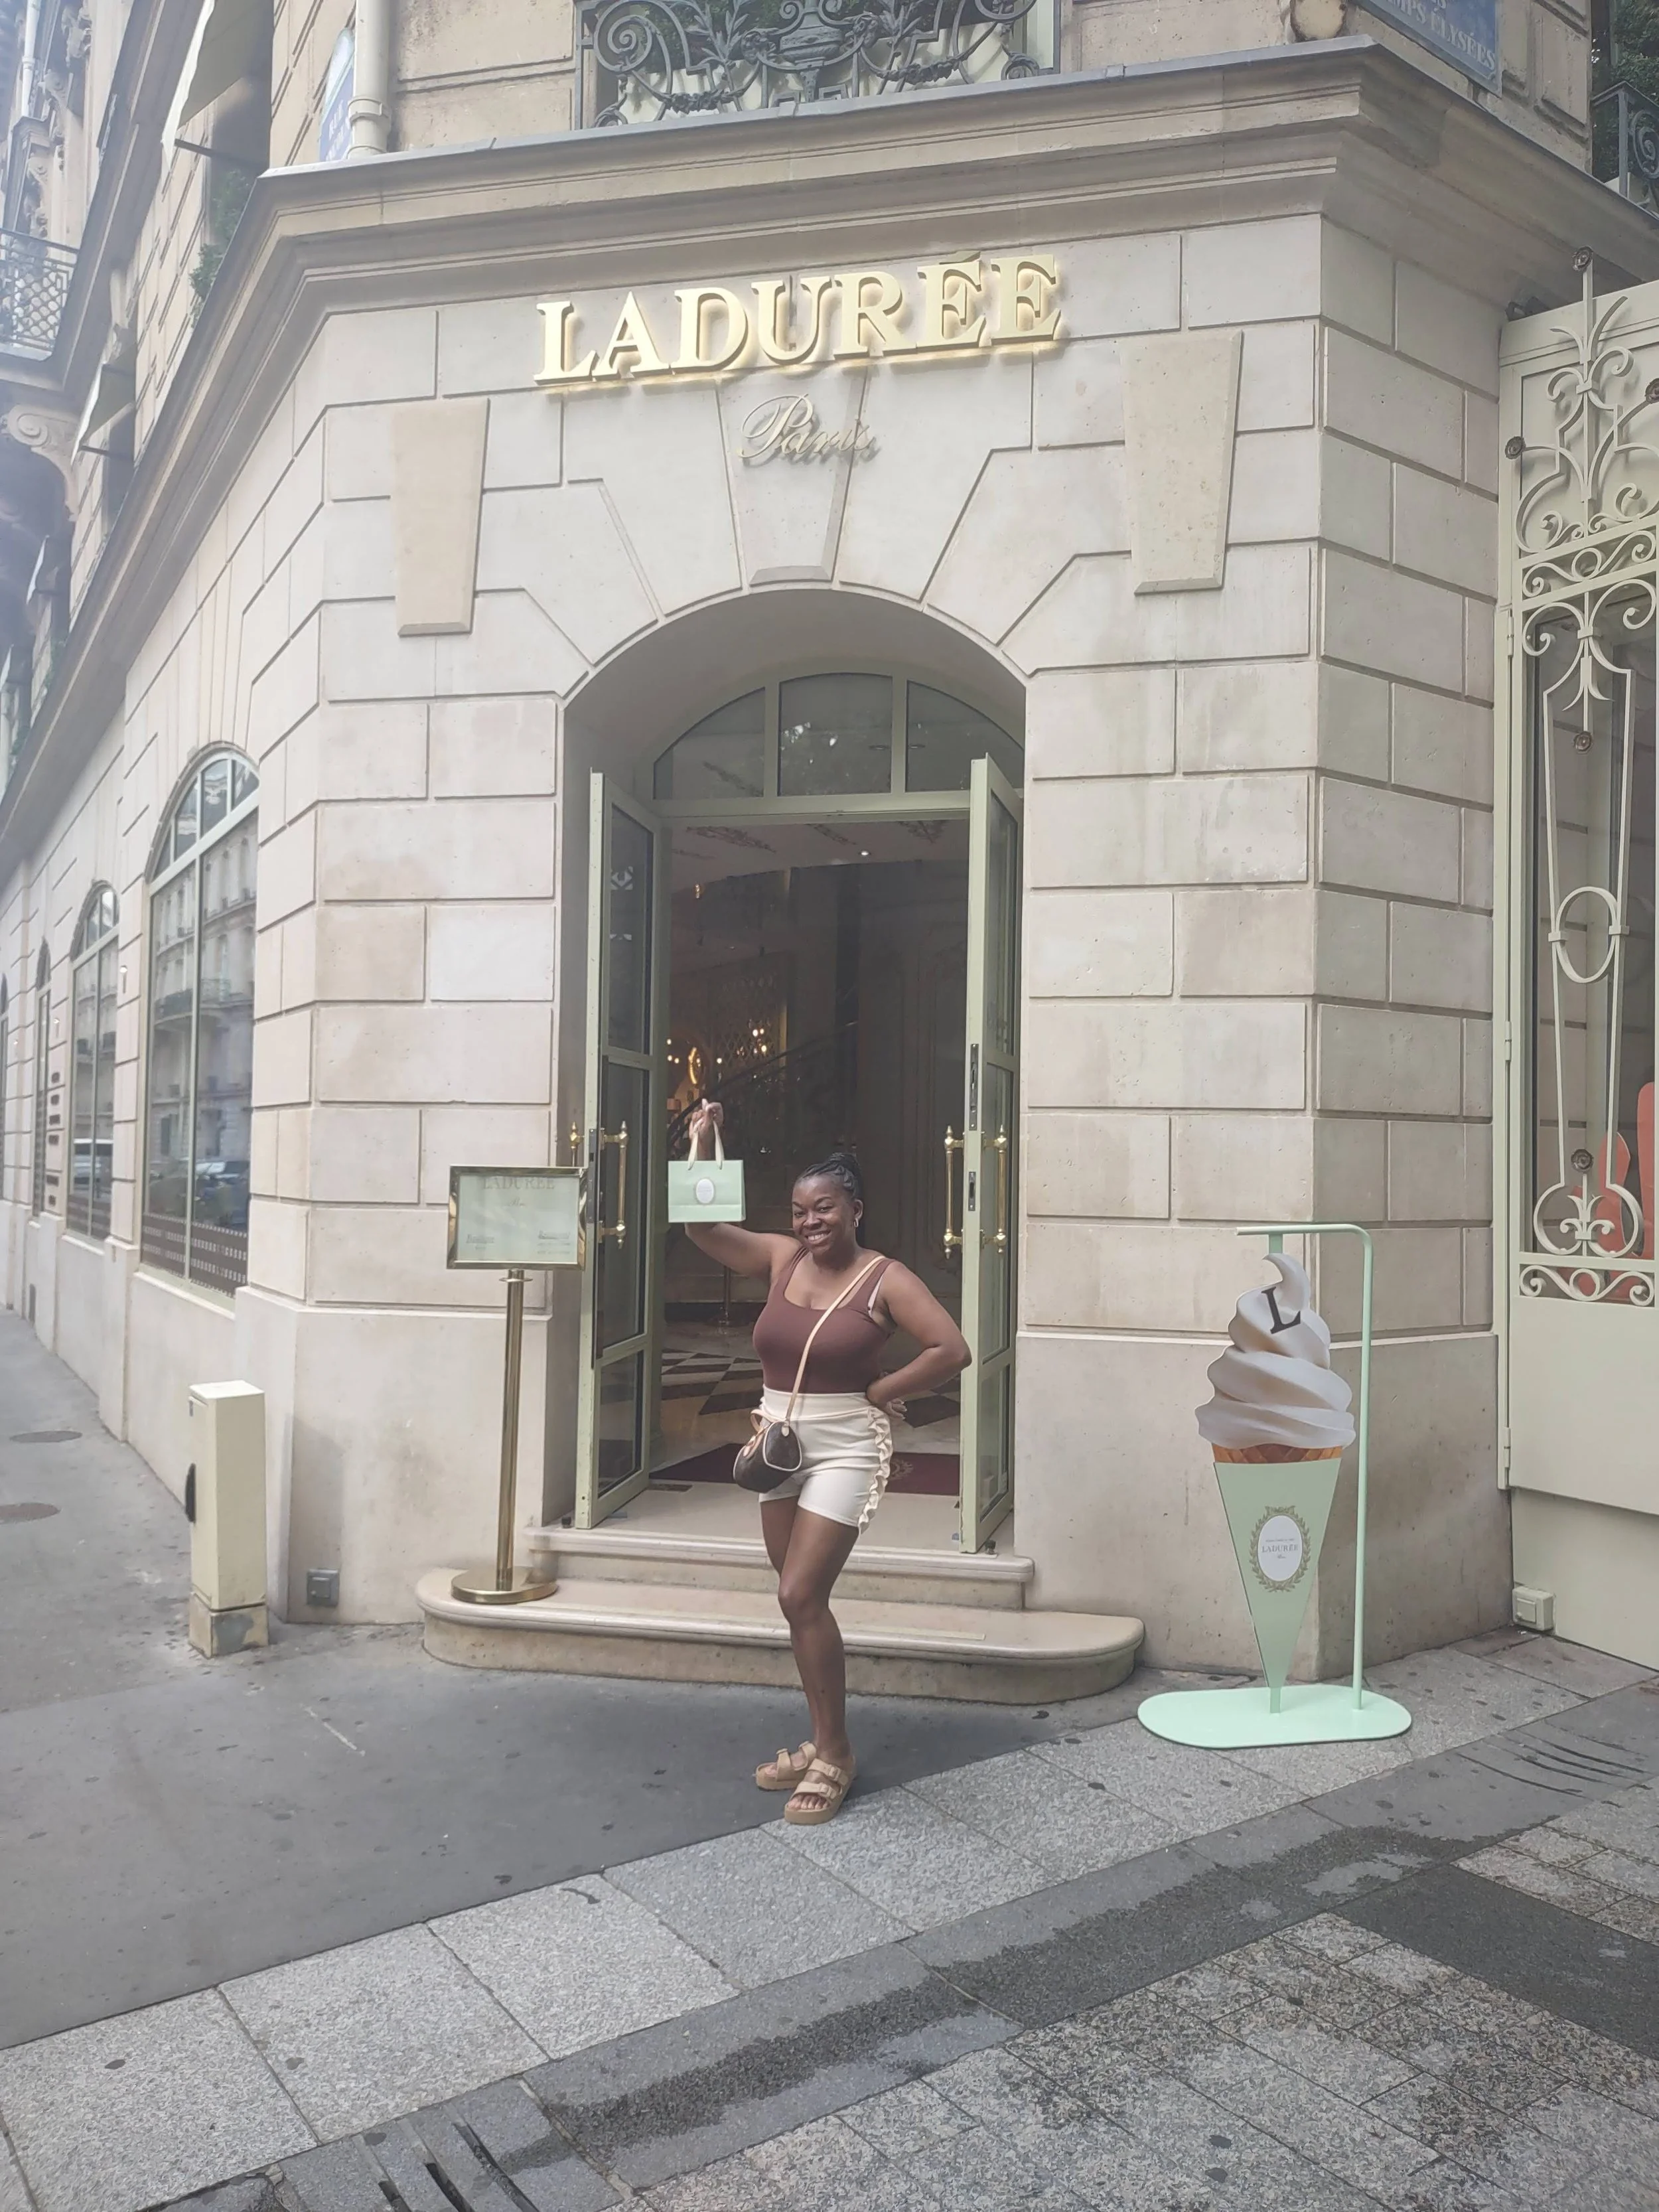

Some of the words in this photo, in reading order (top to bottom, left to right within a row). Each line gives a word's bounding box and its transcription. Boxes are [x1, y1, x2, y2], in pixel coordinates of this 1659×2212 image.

[1431, 7, 1495, 70] ÉLYSÉES
[534, 250, 1061, 385] LADURÉE
[738, 394, 877, 459] Paris
[1261, 1286, 1301, 1335] L
